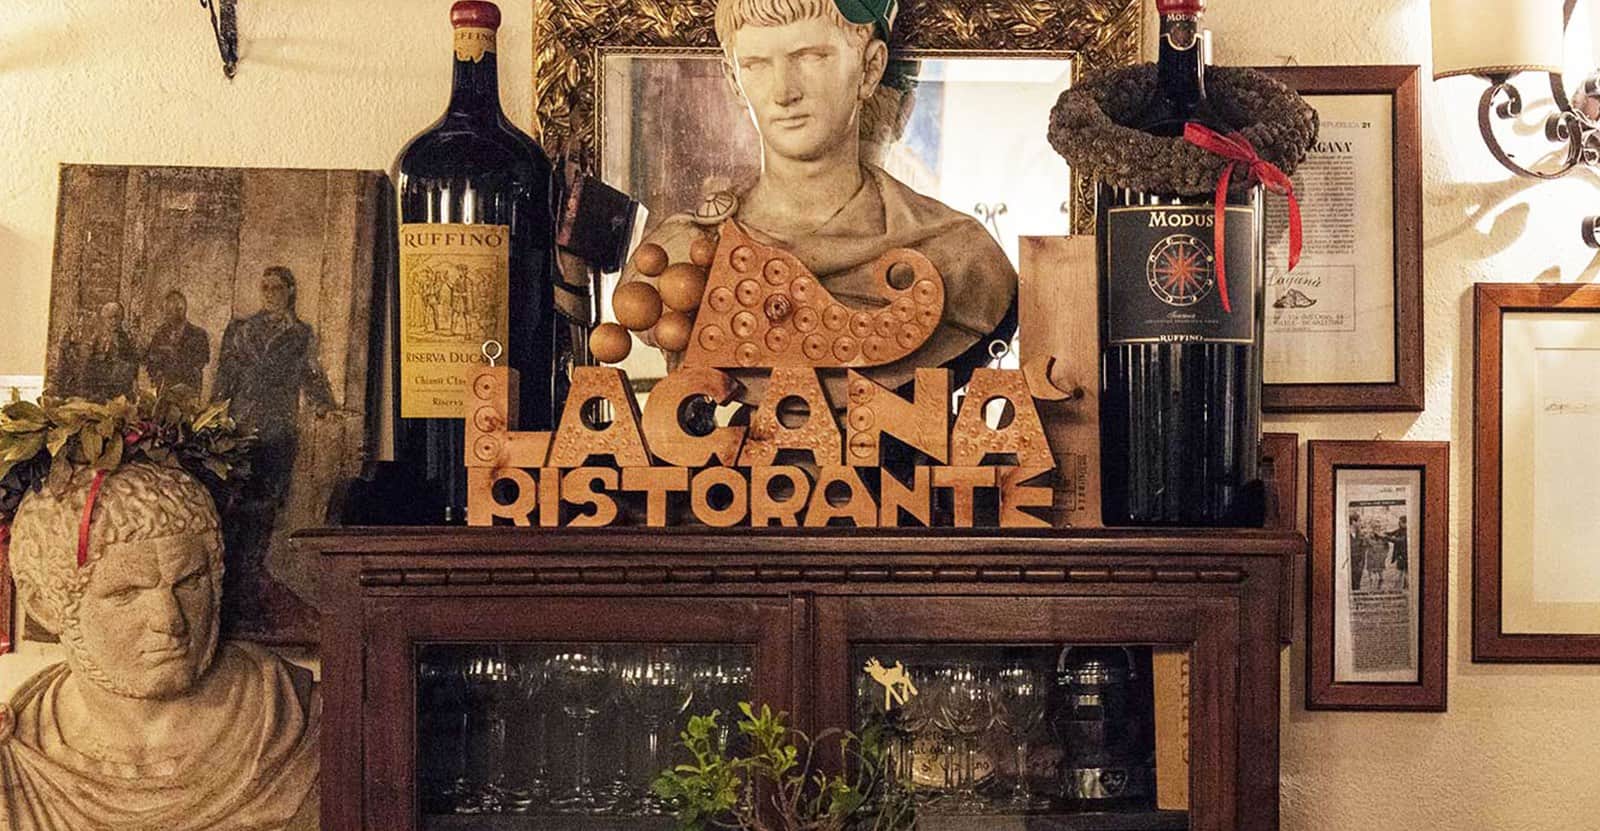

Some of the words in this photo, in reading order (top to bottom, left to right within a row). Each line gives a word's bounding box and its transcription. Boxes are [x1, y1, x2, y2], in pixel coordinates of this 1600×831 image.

[1149, 211, 1214, 228] MODUS
[404, 232, 503, 248] RUFFINO
[1160, 334, 1204, 343] RUFFINO
[405, 352, 447, 363] RISERVA
[449, 351, 491, 364] DUCA
[466, 464, 1055, 528] RISTORANTE
